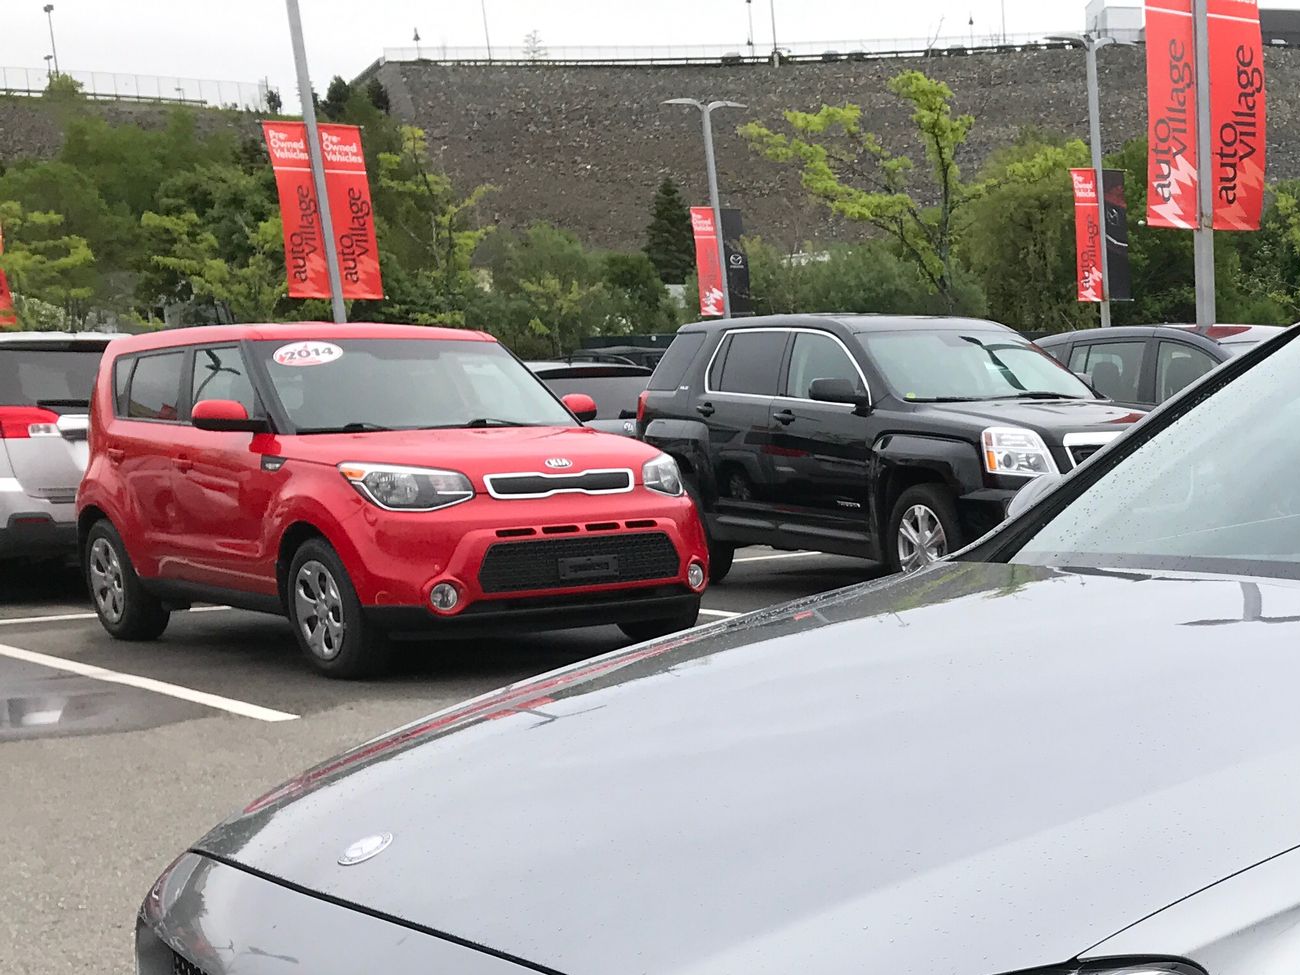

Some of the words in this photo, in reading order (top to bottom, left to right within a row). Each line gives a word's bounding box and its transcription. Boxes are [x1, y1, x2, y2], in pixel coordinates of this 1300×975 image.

[1166, 39, 1192, 159] village
[1232, 45, 1263, 162] village
[268, 129, 288, 140] Pre-
[270, 138, 304, 150] Owned
[273, 149, 309, 161] Vehicles
[322, 132, 341, 143] Pre-
[322, 141, 358, 152] Owned
[325, 152, 363, 163] Vehicles
[1154, 118, 1171, 203] auto
[1218, 122, 1238, 205] auto
[297, 185, 317, 257] village
[348, 188, 371, 258] village
[290, 232, 307, 284] auto
[339, 234, 359, 284] auto
[284, 347, 334, 361] 2014
